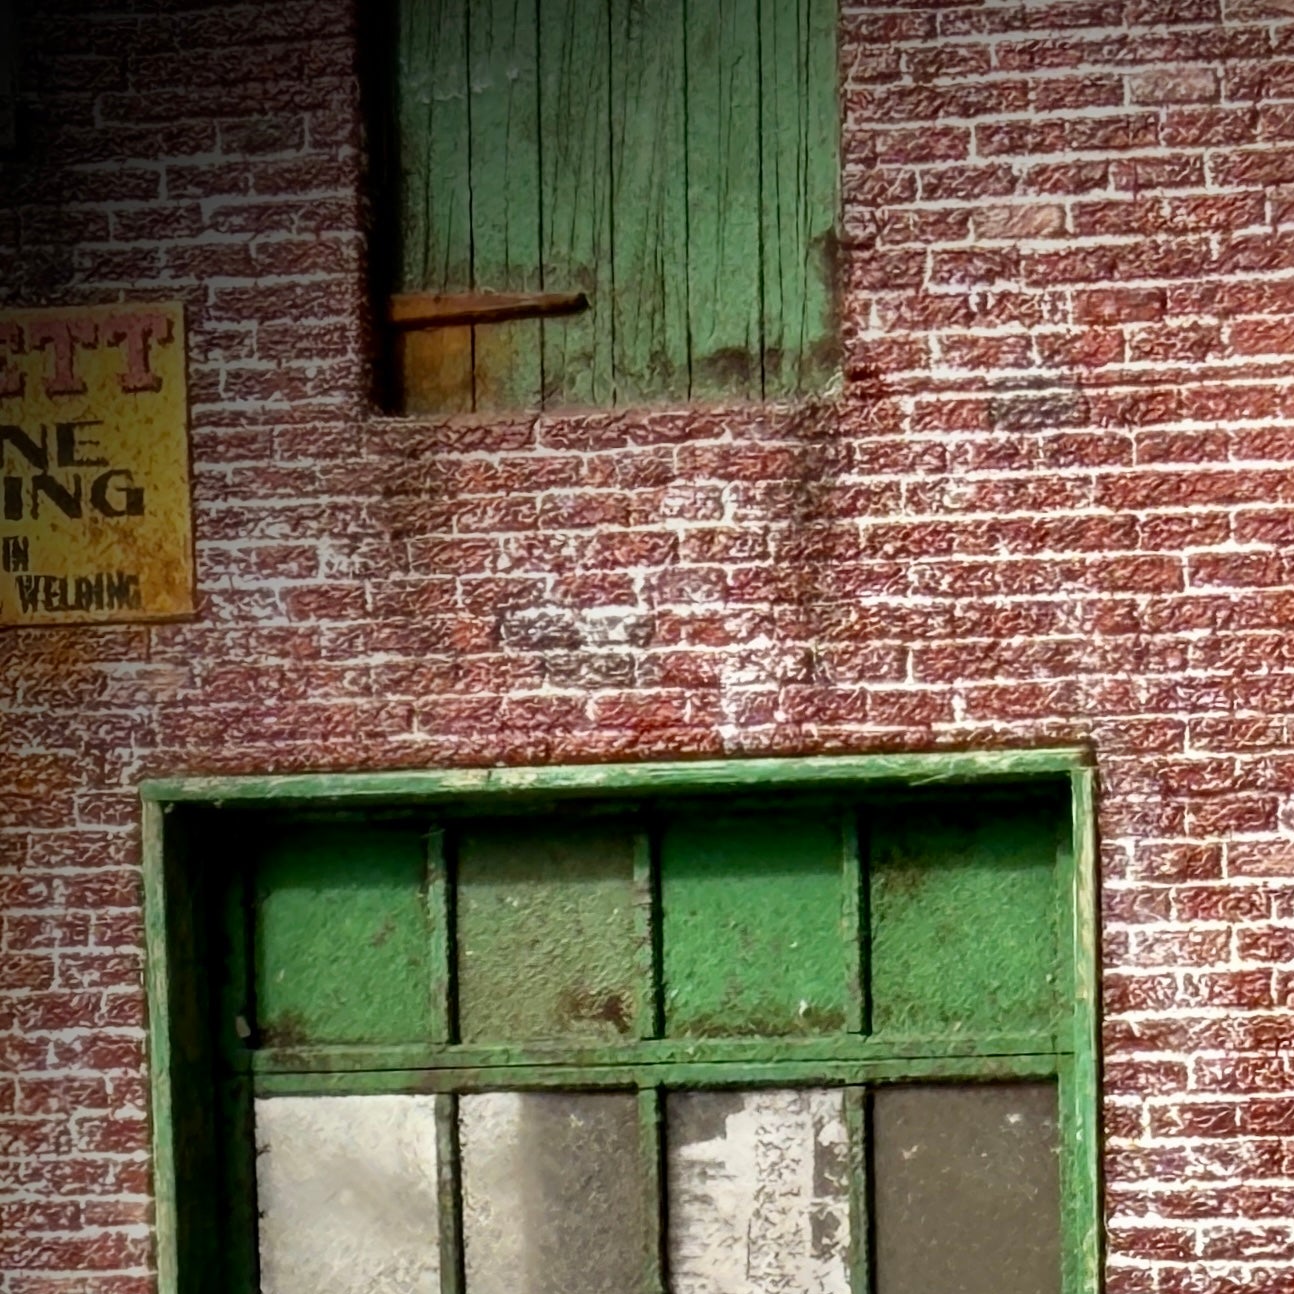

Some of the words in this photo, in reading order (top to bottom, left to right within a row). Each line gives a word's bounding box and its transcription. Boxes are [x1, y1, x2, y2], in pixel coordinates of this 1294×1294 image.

[0, 420, 109, 470] NE
[3, 469, 144, 520] ING
[2, 536, 29, 572] IN
[15, 572, 141, 613] WELDING
